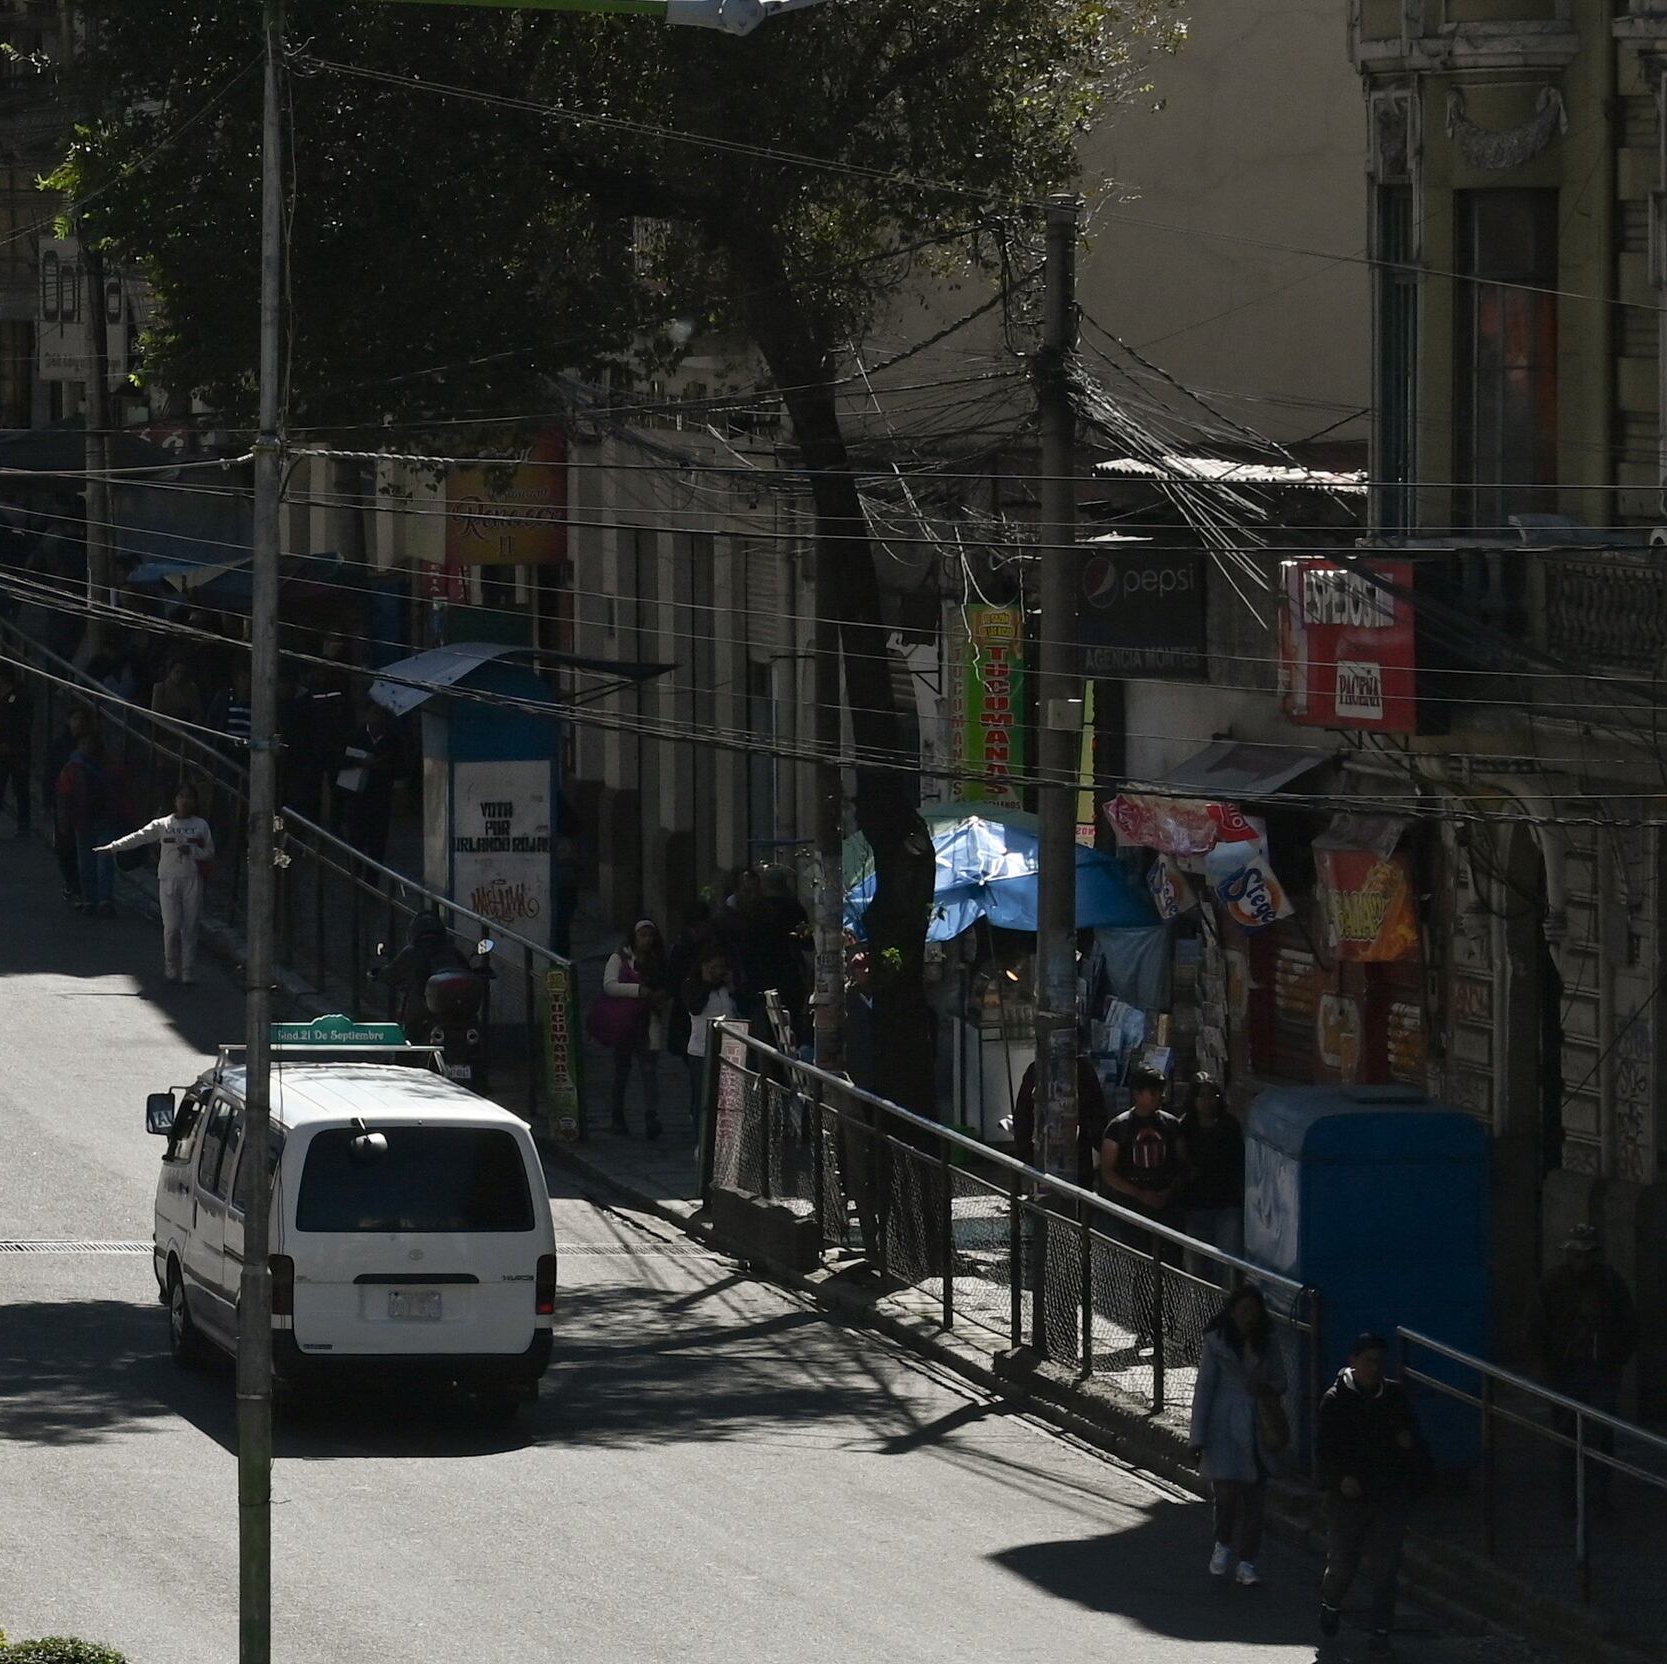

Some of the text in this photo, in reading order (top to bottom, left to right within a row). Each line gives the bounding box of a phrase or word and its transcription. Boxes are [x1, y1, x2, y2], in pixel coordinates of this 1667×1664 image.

[1123, 563, 1195, 599] pepsi
[1085, 646, 1198, 670] AGENCIA MONTES
[981, 643, 1015, 796] TUCUMANAS
[1236, 866, 1279, 923] Stege
[315, 1031, 328, 1041] De
[331, 1031, 384, 1043] Septiembre
